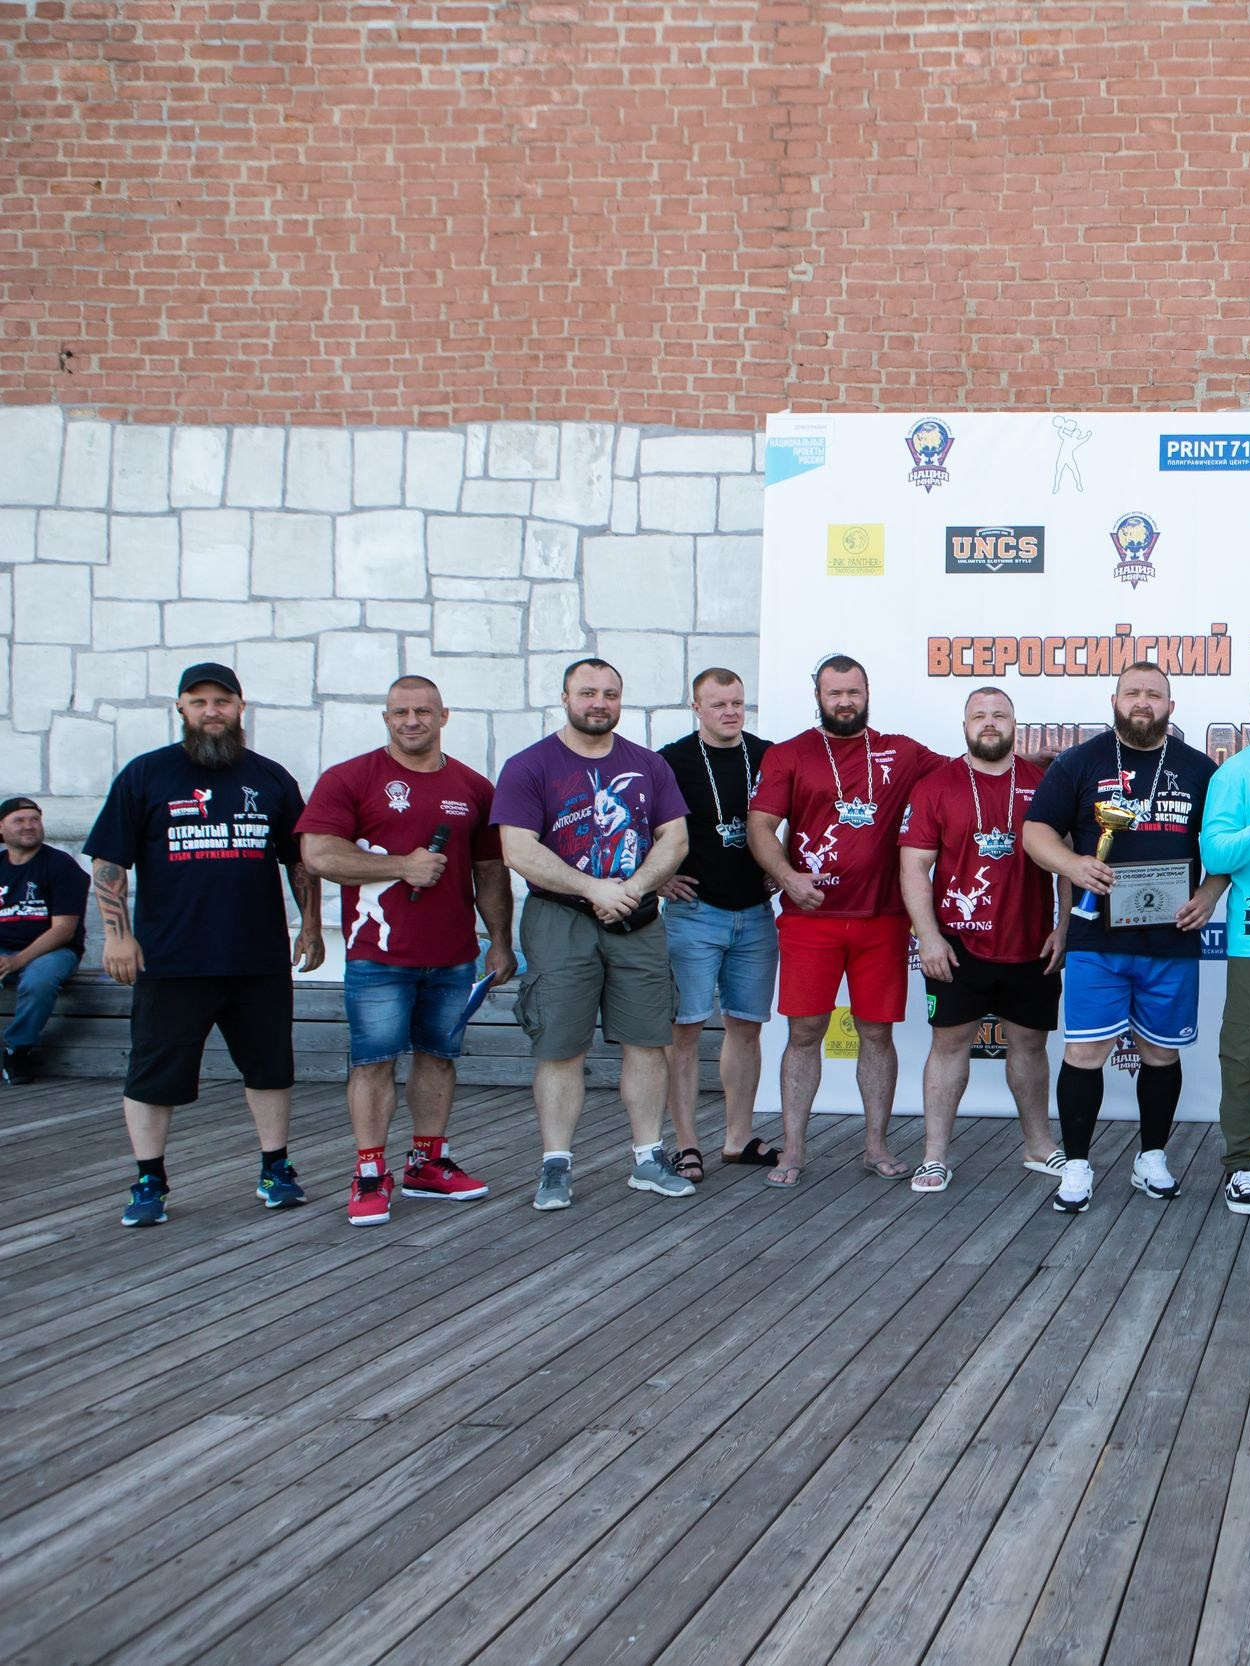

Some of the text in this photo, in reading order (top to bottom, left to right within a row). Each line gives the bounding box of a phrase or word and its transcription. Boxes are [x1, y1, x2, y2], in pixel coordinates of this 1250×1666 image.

[1167, 440, 1250, 458] PRINT 71
[909, 470, 950, 482] НАЦИЯ
[952, 536, 1038, 559] UNCS
[1113, 565, 1156, 578] НАЦИЯ
[927, 623, 1231, 677] ВСЕРОССИЙСКИЙ
[1015, 787, 1036, 796] Strong
[1156, 800, 1192, 815] ТУРНИР
[552, 806, 593, 831] INTRODUCE
[168, 822, 270, 840] ОТКРЫТЫЙ ТУРНИР
[182, 838, 228, 850] СИЛОВОМУ
[1143, 893, 1155, 908] 2
[946, 920, 993, 931] TRONG
